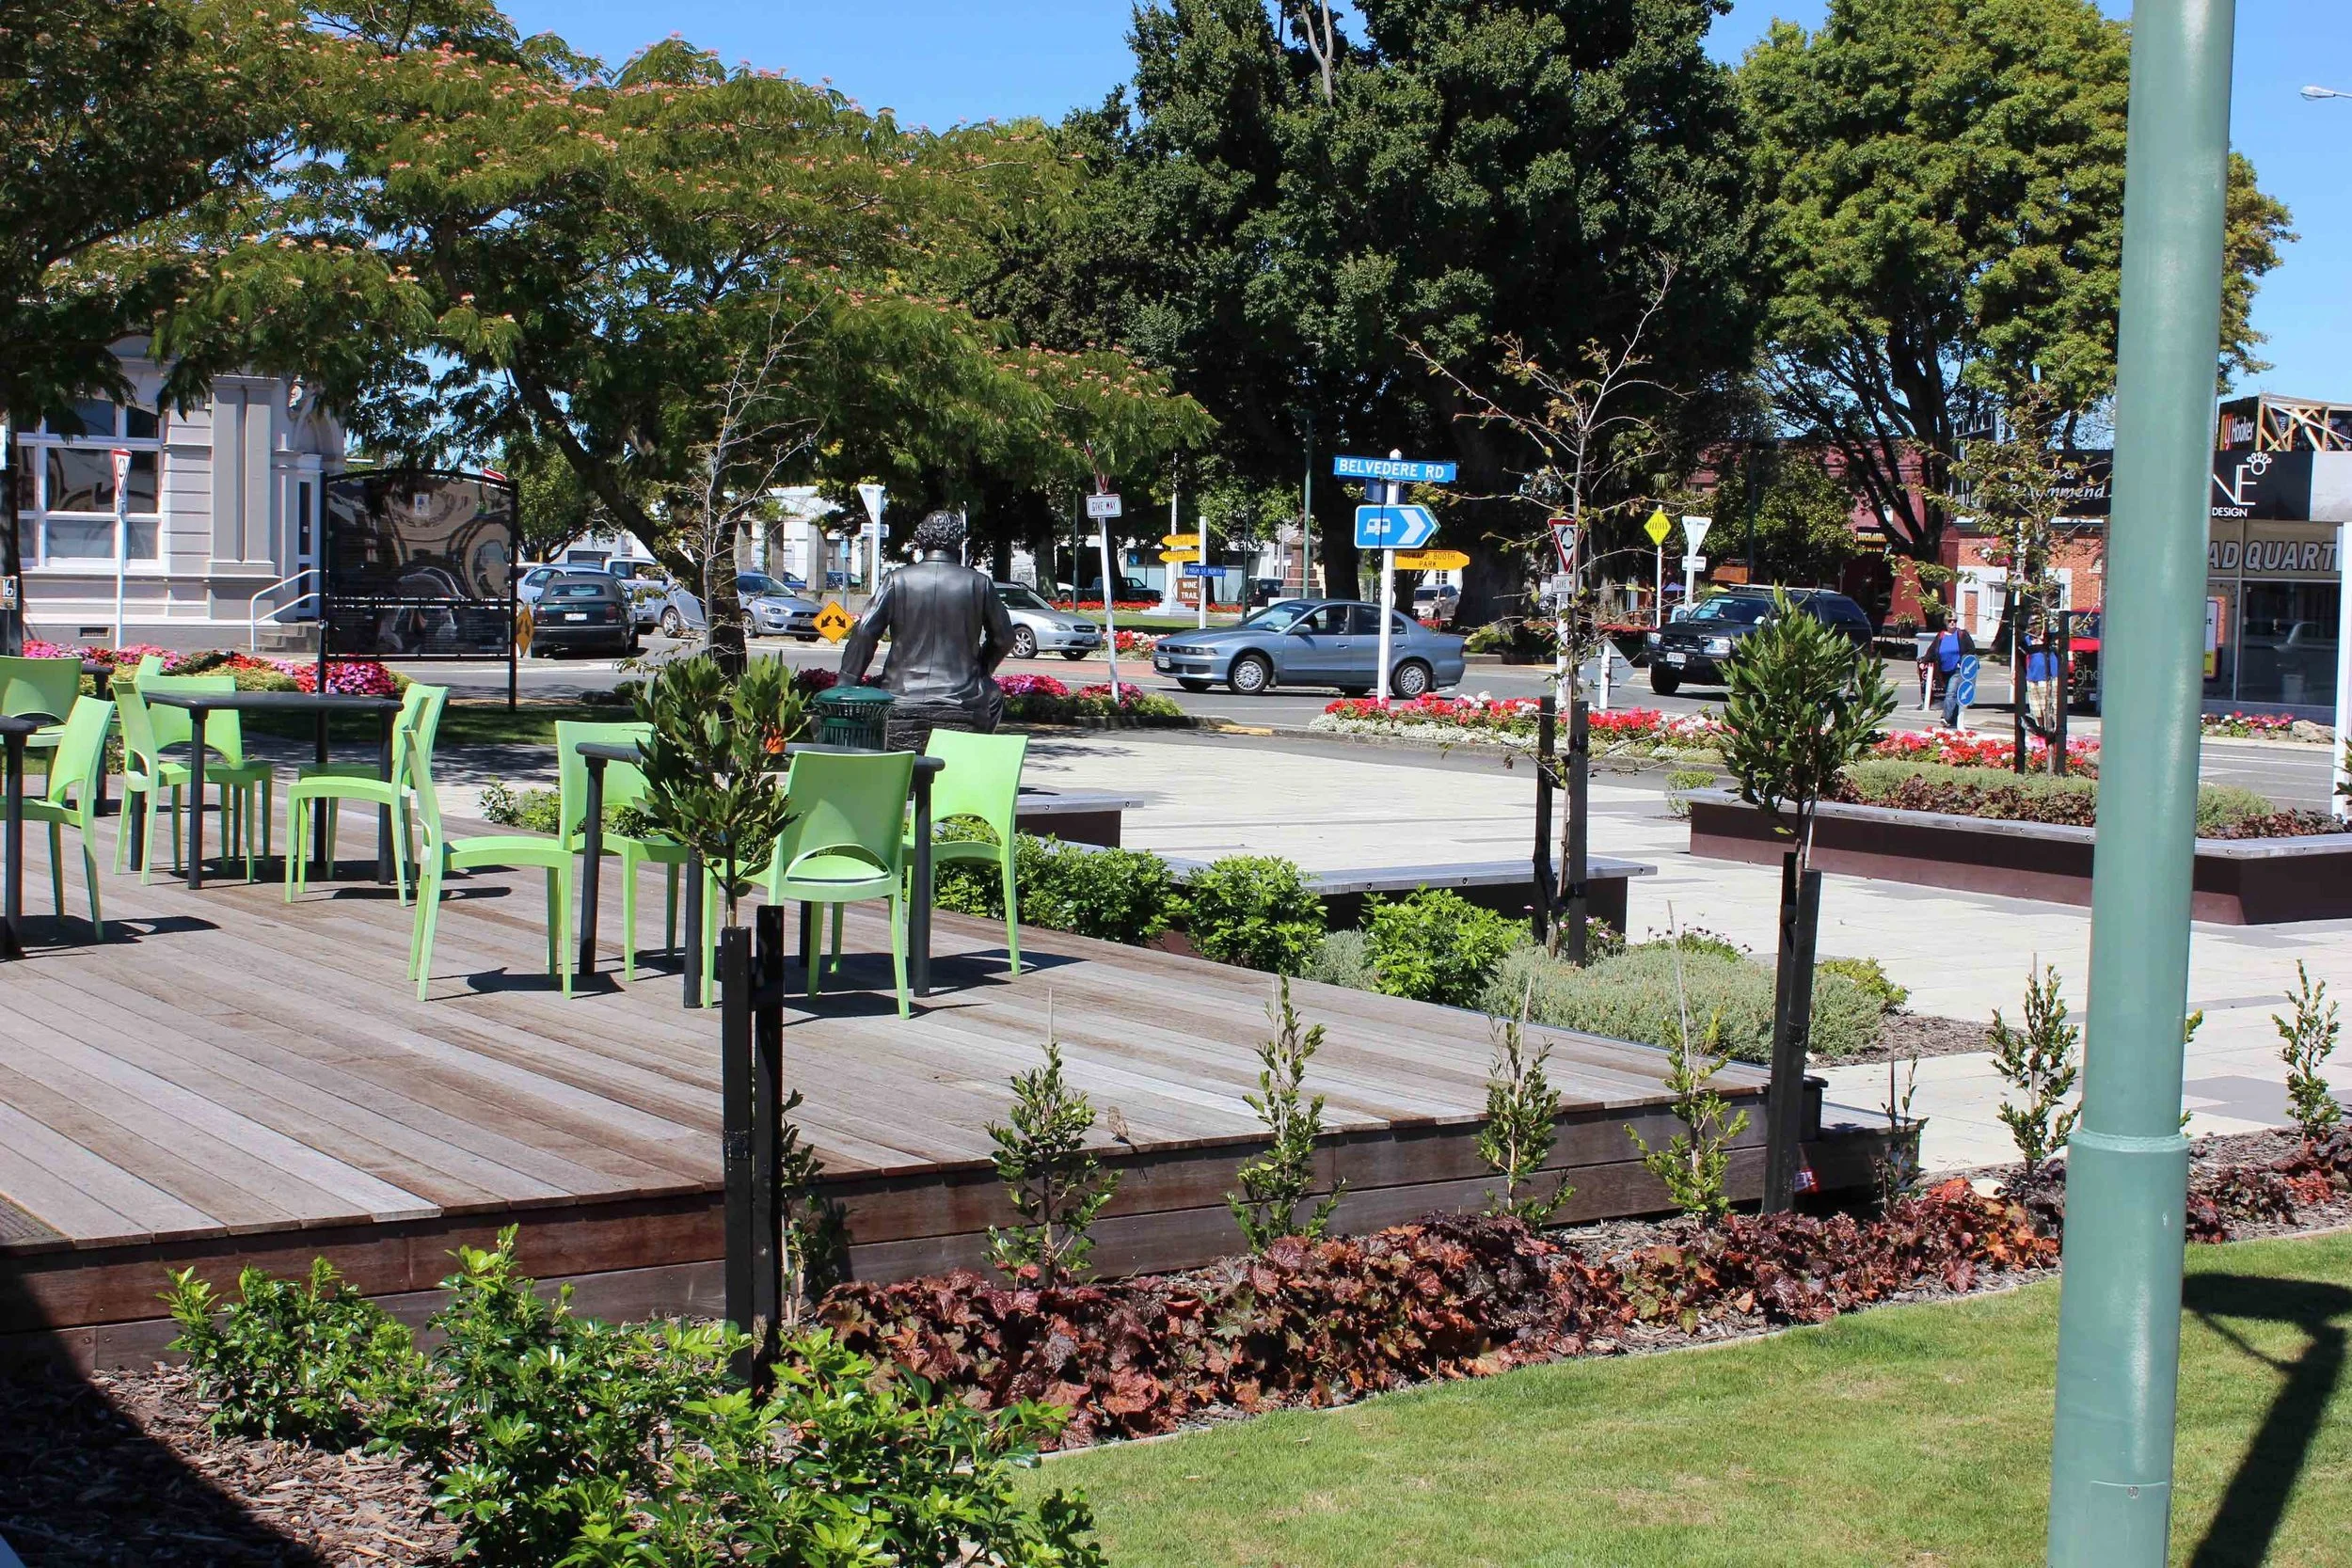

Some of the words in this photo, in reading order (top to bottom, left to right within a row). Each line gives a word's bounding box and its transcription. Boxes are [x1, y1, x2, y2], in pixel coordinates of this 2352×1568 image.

[2231, 416, 2255, 443] Hooker
[1339, 459, 1418, 477] BELVEDERE
[1425, 465, 1445, 479] RD
[1091, 501, 1104, 513] GIVE
[1105, 500, 1117, 512] WAY
[2212, 507, 2248, 517] DESIGN
[1433, 551, 1455, 561] BOOTH
[1419, 560, 1437, 568] PARK
[1182, 580, 1198, 589] WINE
